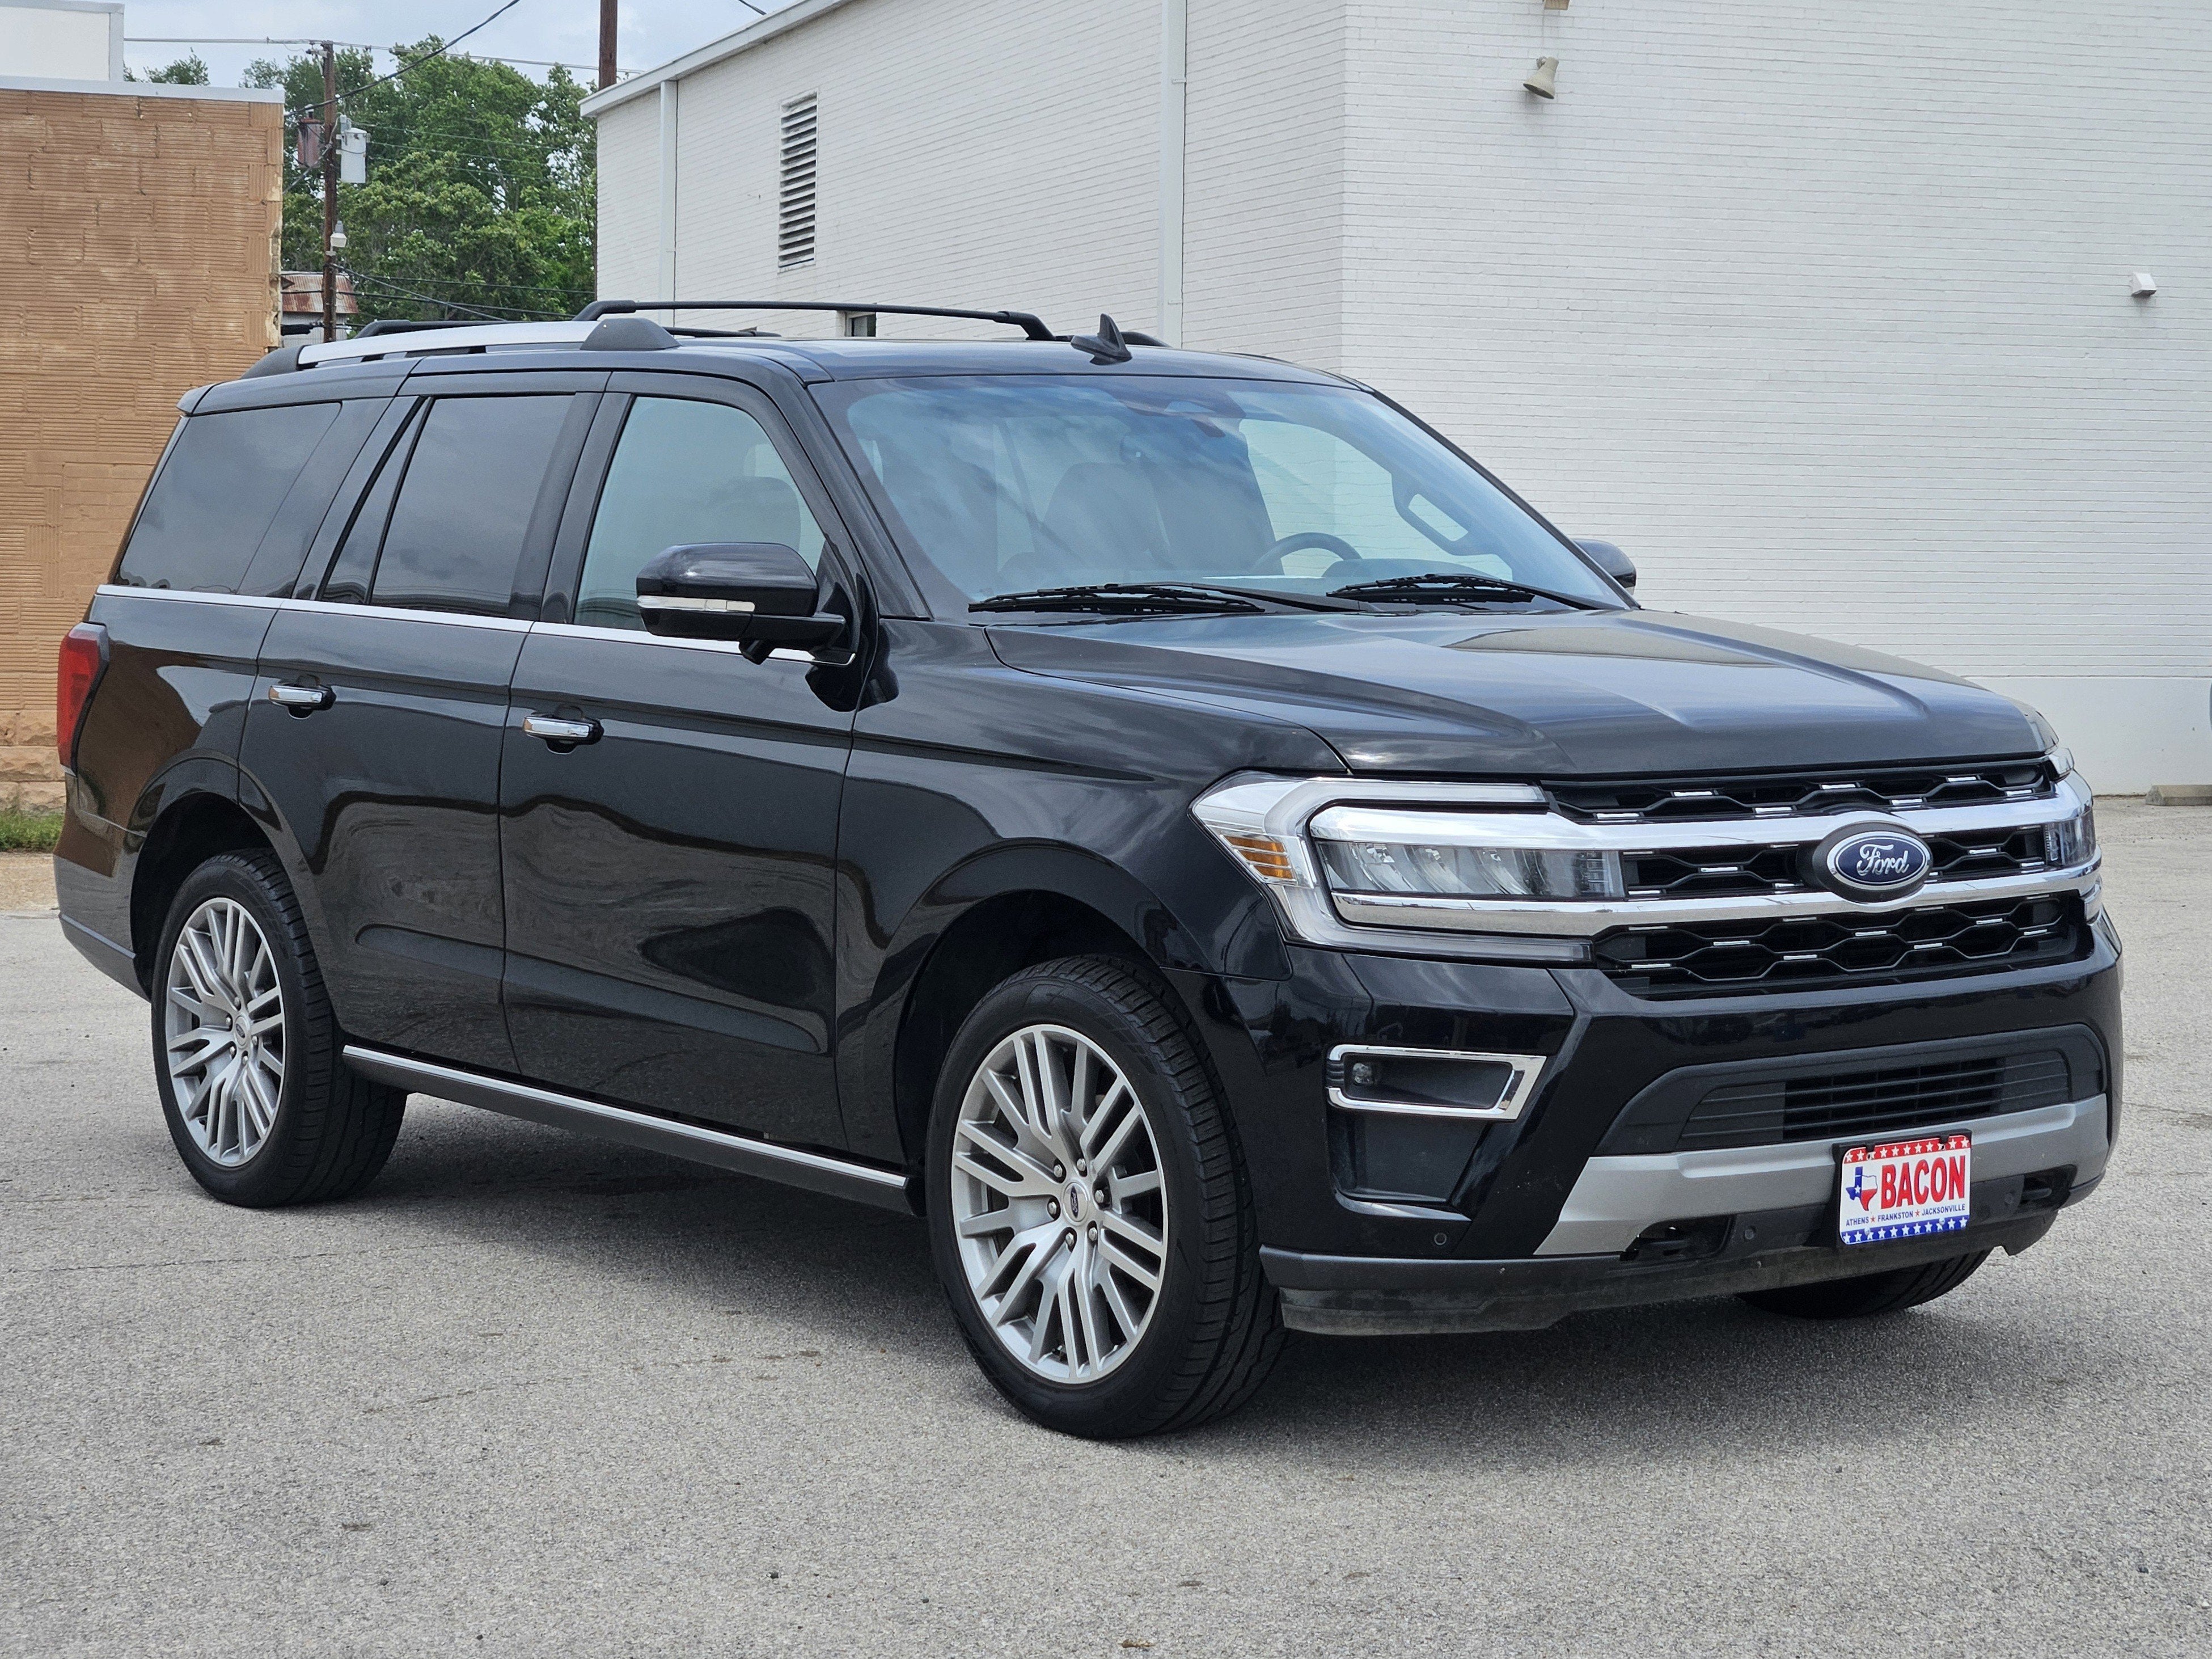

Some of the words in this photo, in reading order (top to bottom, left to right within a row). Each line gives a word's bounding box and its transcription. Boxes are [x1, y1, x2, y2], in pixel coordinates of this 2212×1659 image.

[1856, 844, 1910, 876] Ford
[1881, 1155, 1966, 1209] BACON
[1846, 1217, 1870, 1227] ATHENS
[1877, 1210, 1914, 1222] FRANKSTON
[1922, 1204, 1966, 1217] JACKSONVILLE
